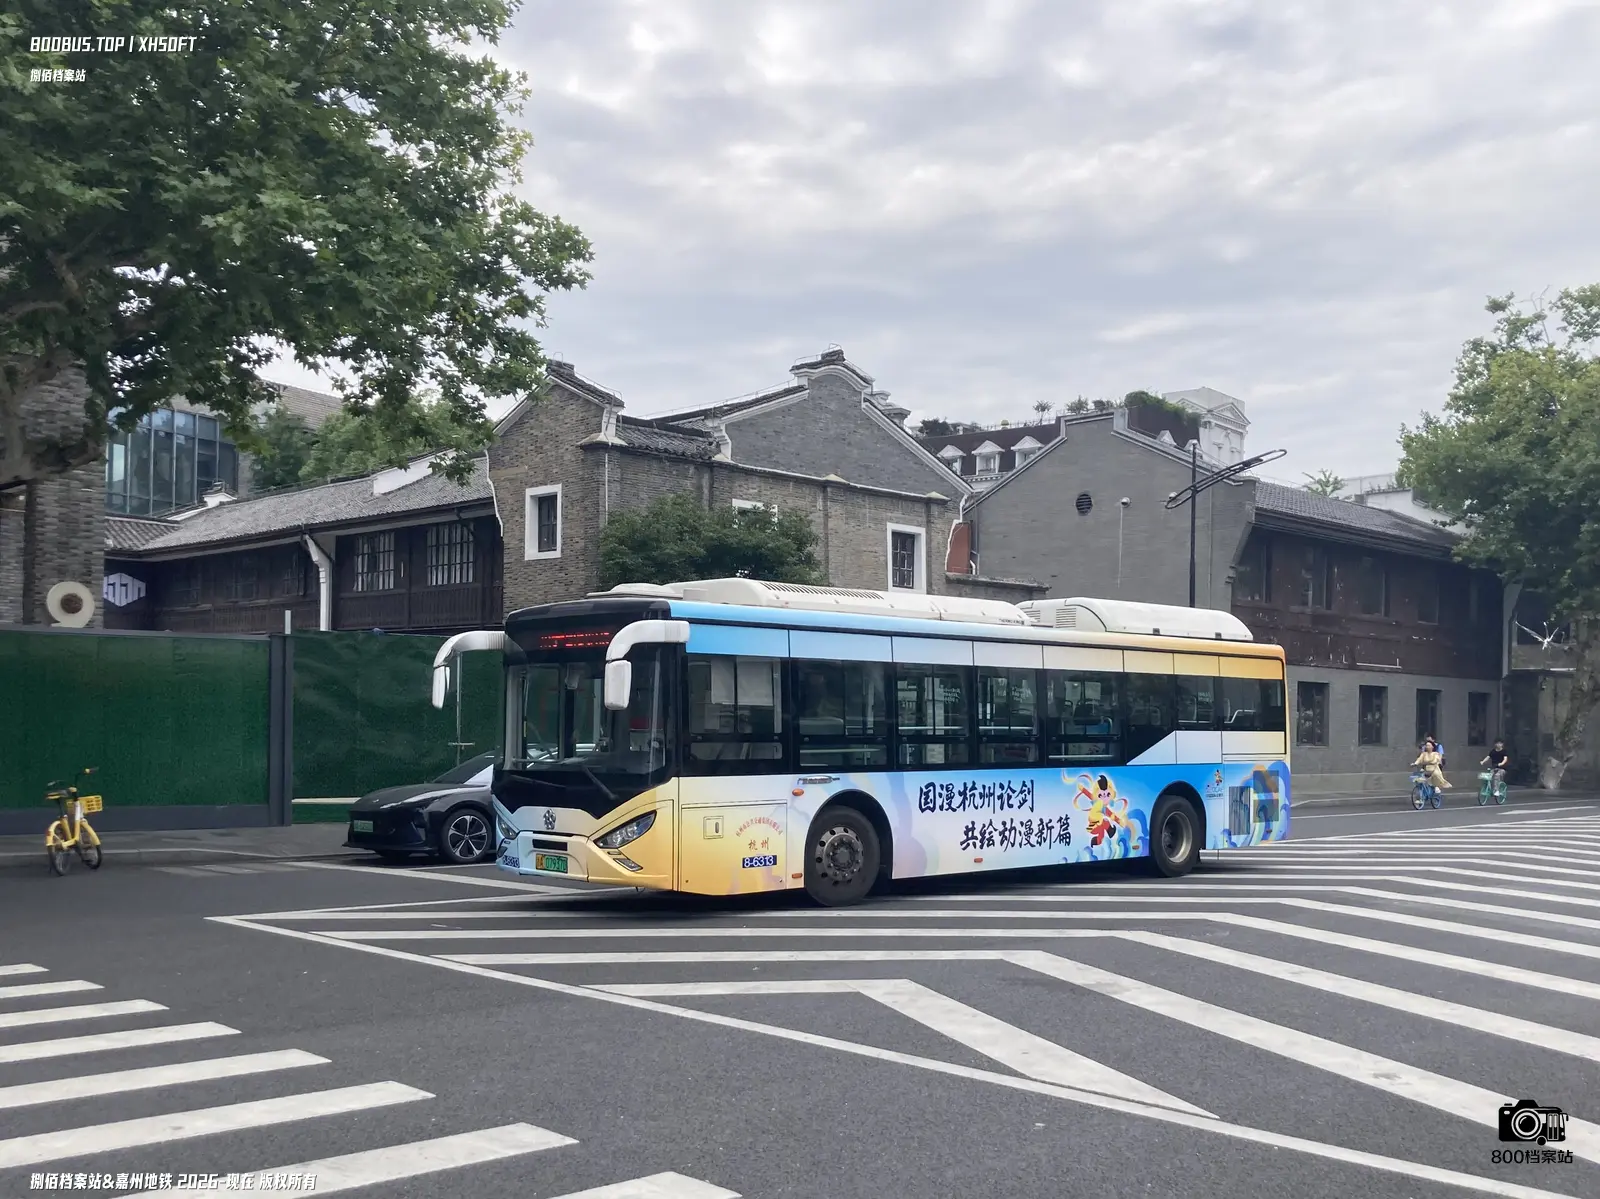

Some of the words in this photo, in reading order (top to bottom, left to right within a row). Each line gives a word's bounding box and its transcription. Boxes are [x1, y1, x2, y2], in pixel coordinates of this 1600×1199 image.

[918, 779, 1035, 815] 国漫杭州论剑
[959, 814, 1072, 853] 共绘动漫新篇
[743, 856, 774, 868] 8-6313
